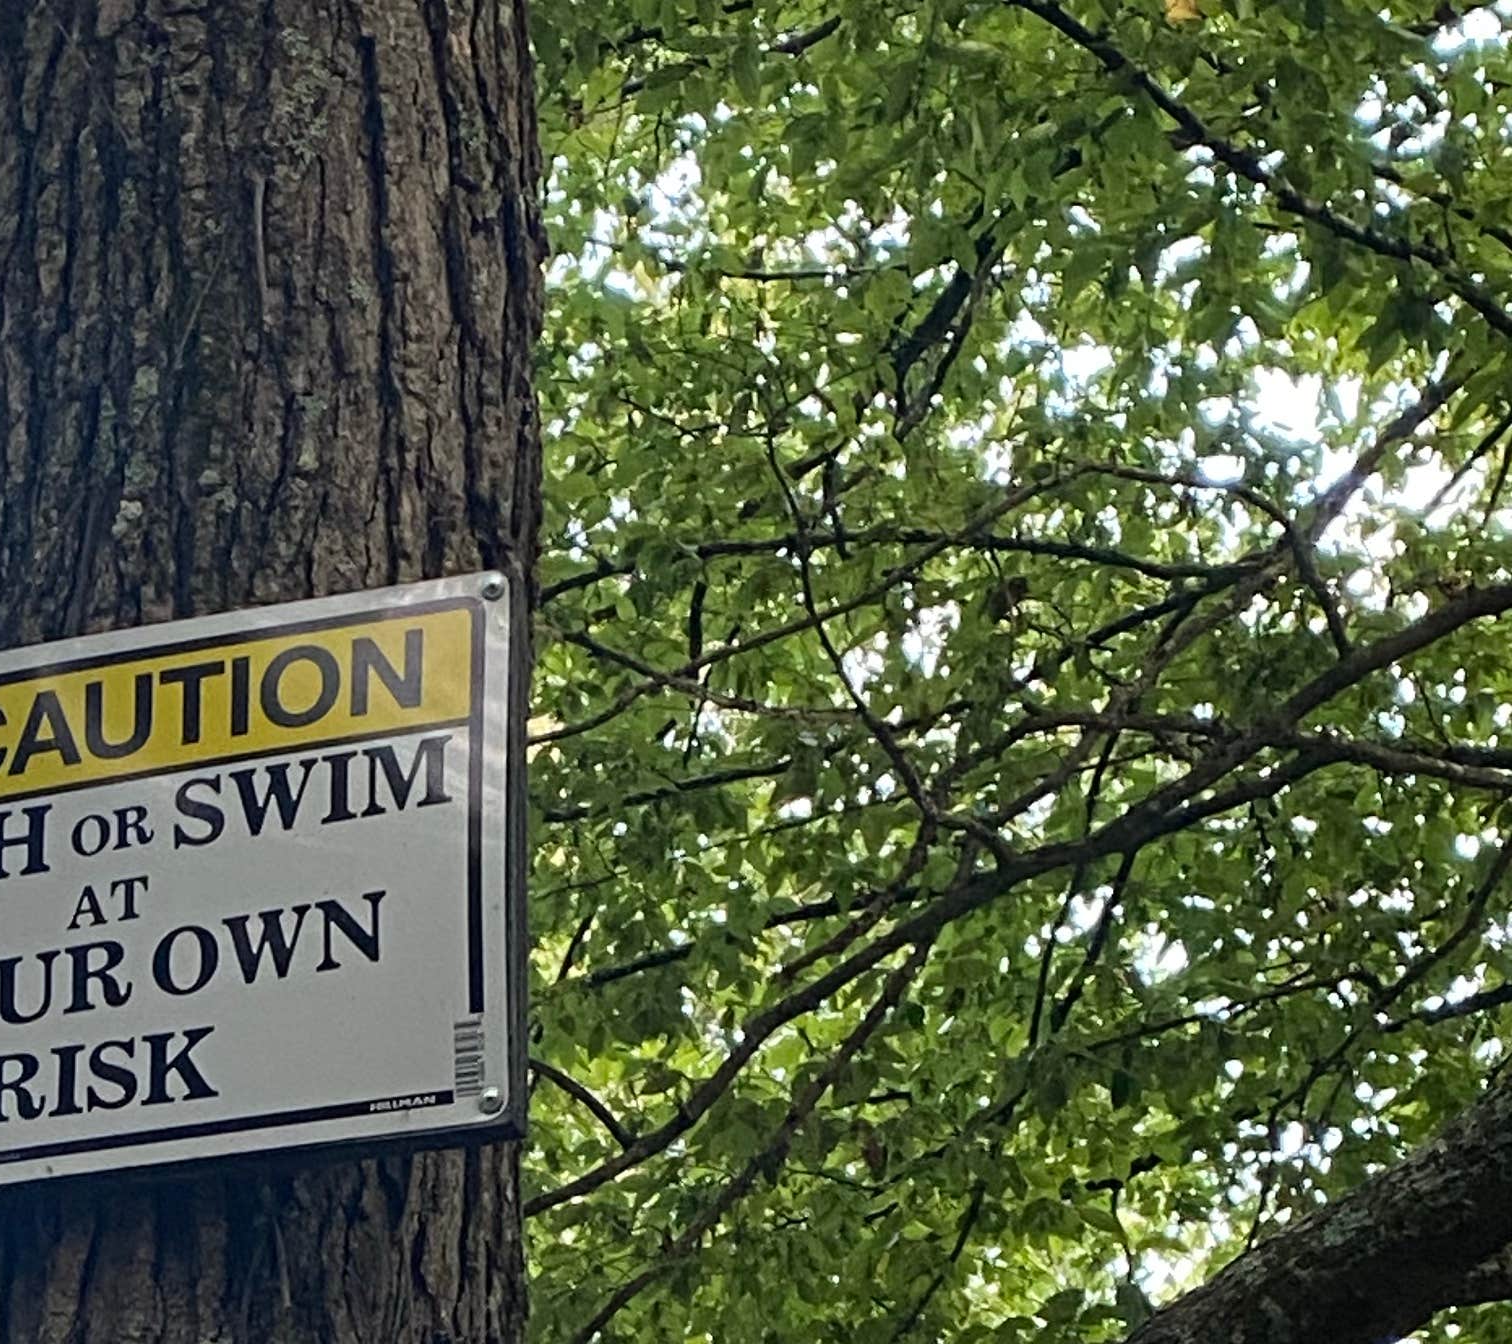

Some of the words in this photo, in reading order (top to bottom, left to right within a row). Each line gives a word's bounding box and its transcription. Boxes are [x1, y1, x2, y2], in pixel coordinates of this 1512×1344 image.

[70, 805, 155, 858] OR
[174, 736, 453, 850] SWIM
[67, 875, 149, 930] AT
[152, 890, 387, 996] OWN
